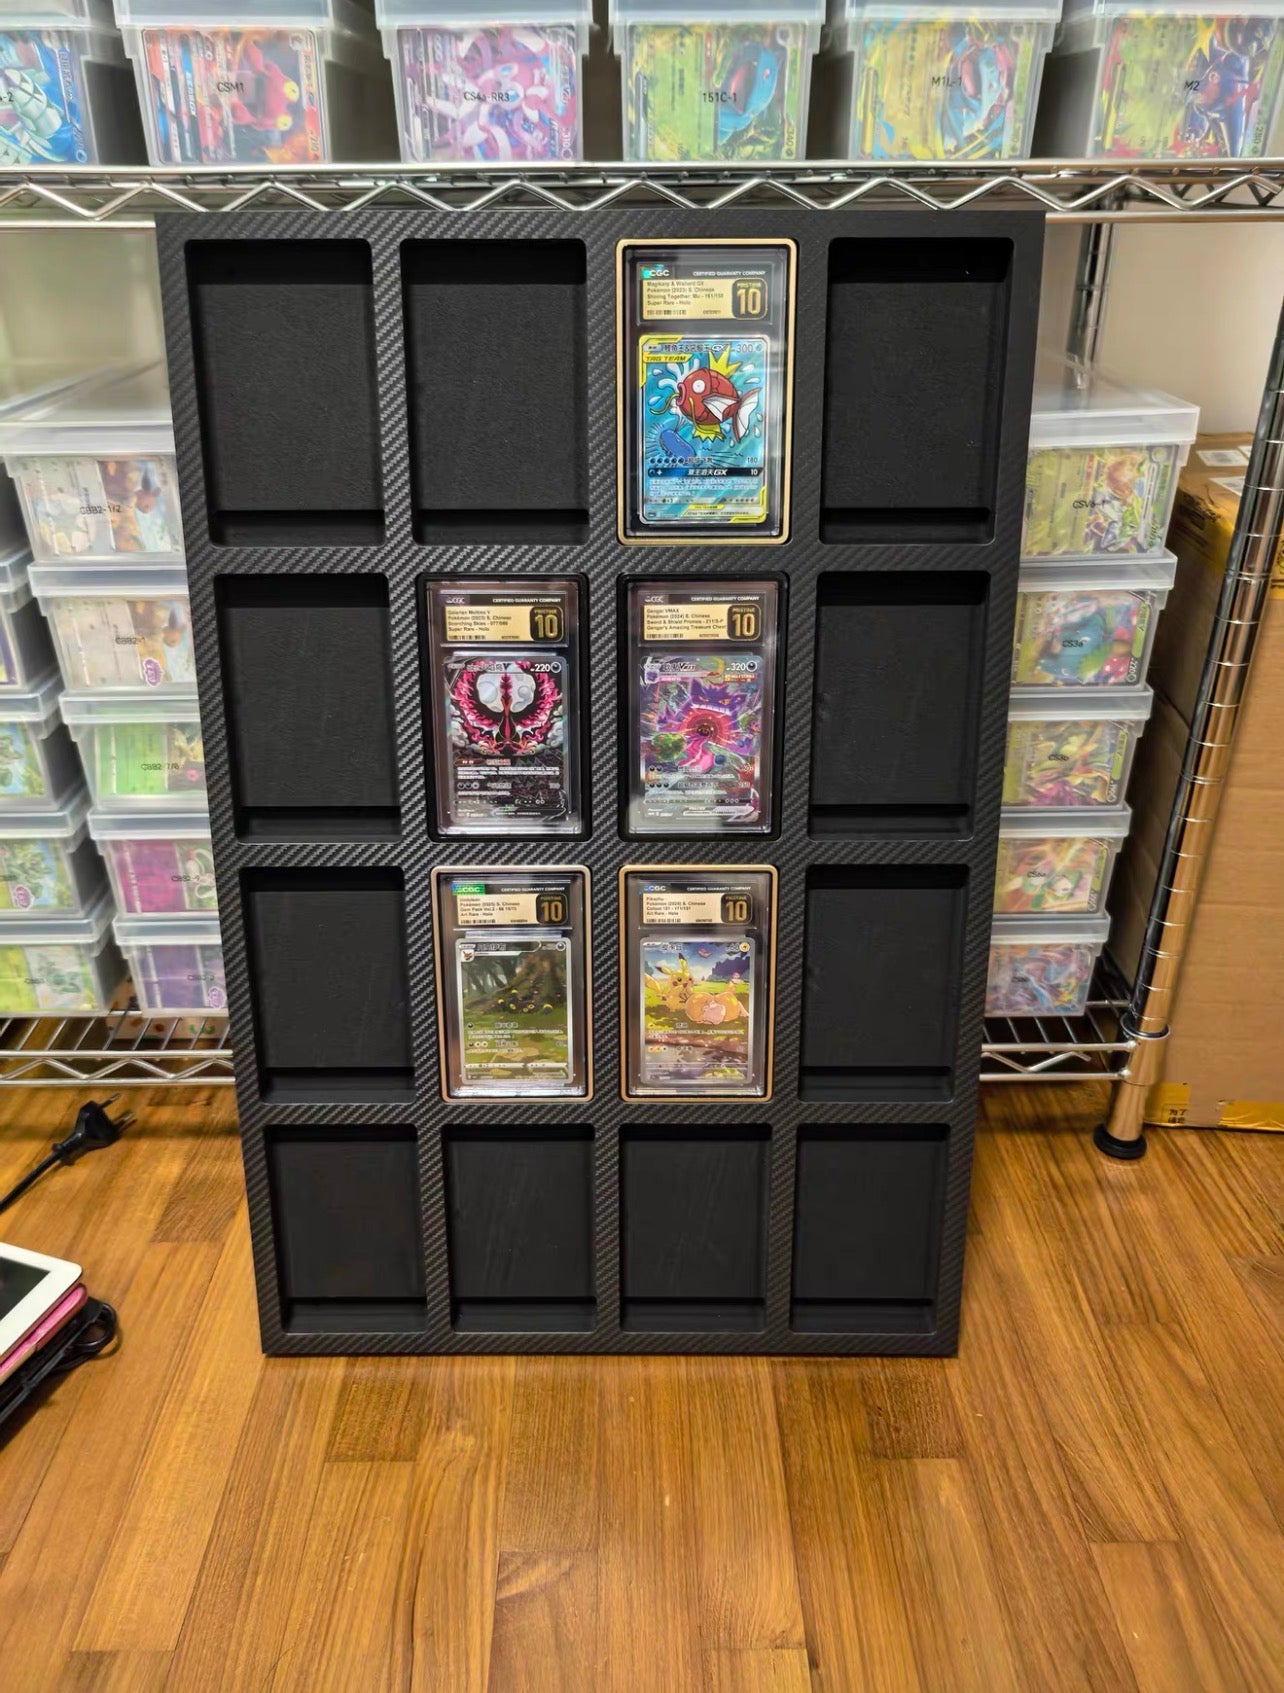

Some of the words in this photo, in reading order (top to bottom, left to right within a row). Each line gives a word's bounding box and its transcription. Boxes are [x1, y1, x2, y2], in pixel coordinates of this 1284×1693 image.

[217, 82, 244, 93] CSM1
[1184, 80, 1201, 91] M2
[463, 91, 510, 102] CS4a-RR3
[702, 92, 737, 103] 151C-1
[737, 288, 761, 315] 10
[535, 615, 558, 638] 10
[732, 614, 755, 636] 10
[534, 663, 551, 672] 220
[731, 662, 746, 671] 320
[541, 901, 562, 921] 10
[726, 901, 747, 921] 10
